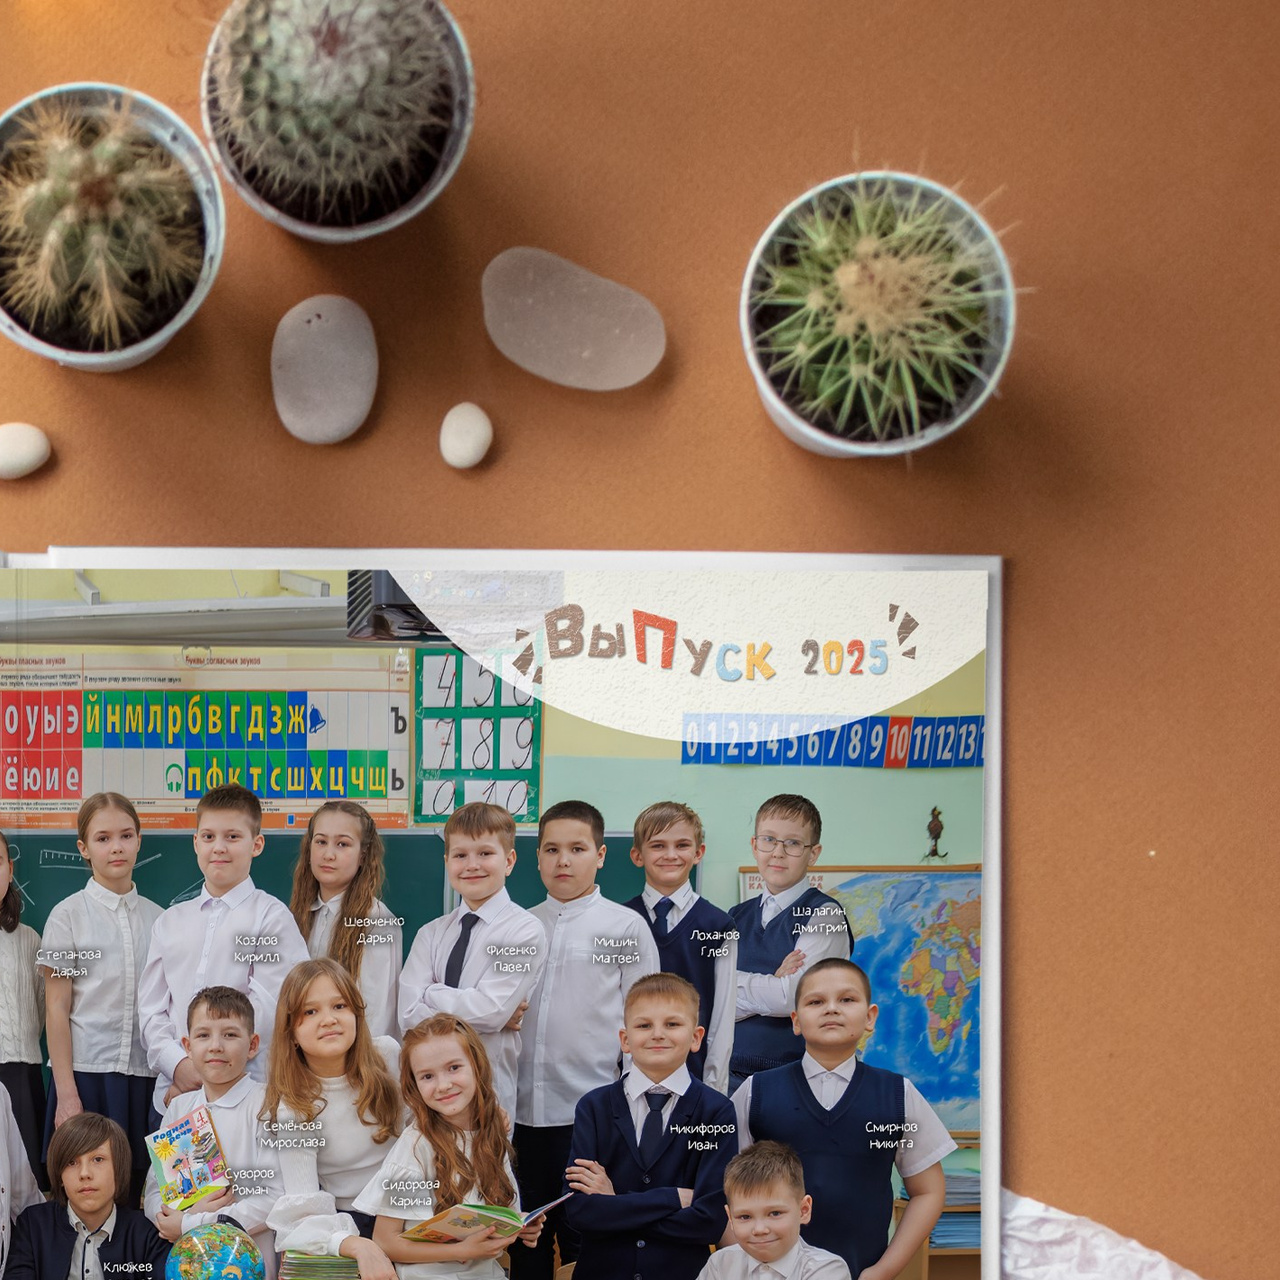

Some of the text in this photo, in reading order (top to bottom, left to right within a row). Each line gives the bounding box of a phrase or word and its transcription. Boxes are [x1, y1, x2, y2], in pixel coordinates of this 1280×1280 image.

[889, 724, 909, 760] 10
[913, 724, 932, 760] 11
[936, 724, 955, 760] 12
[958, 723, 977, 760] 13
[153, 1119, 190, 1143] Родная
